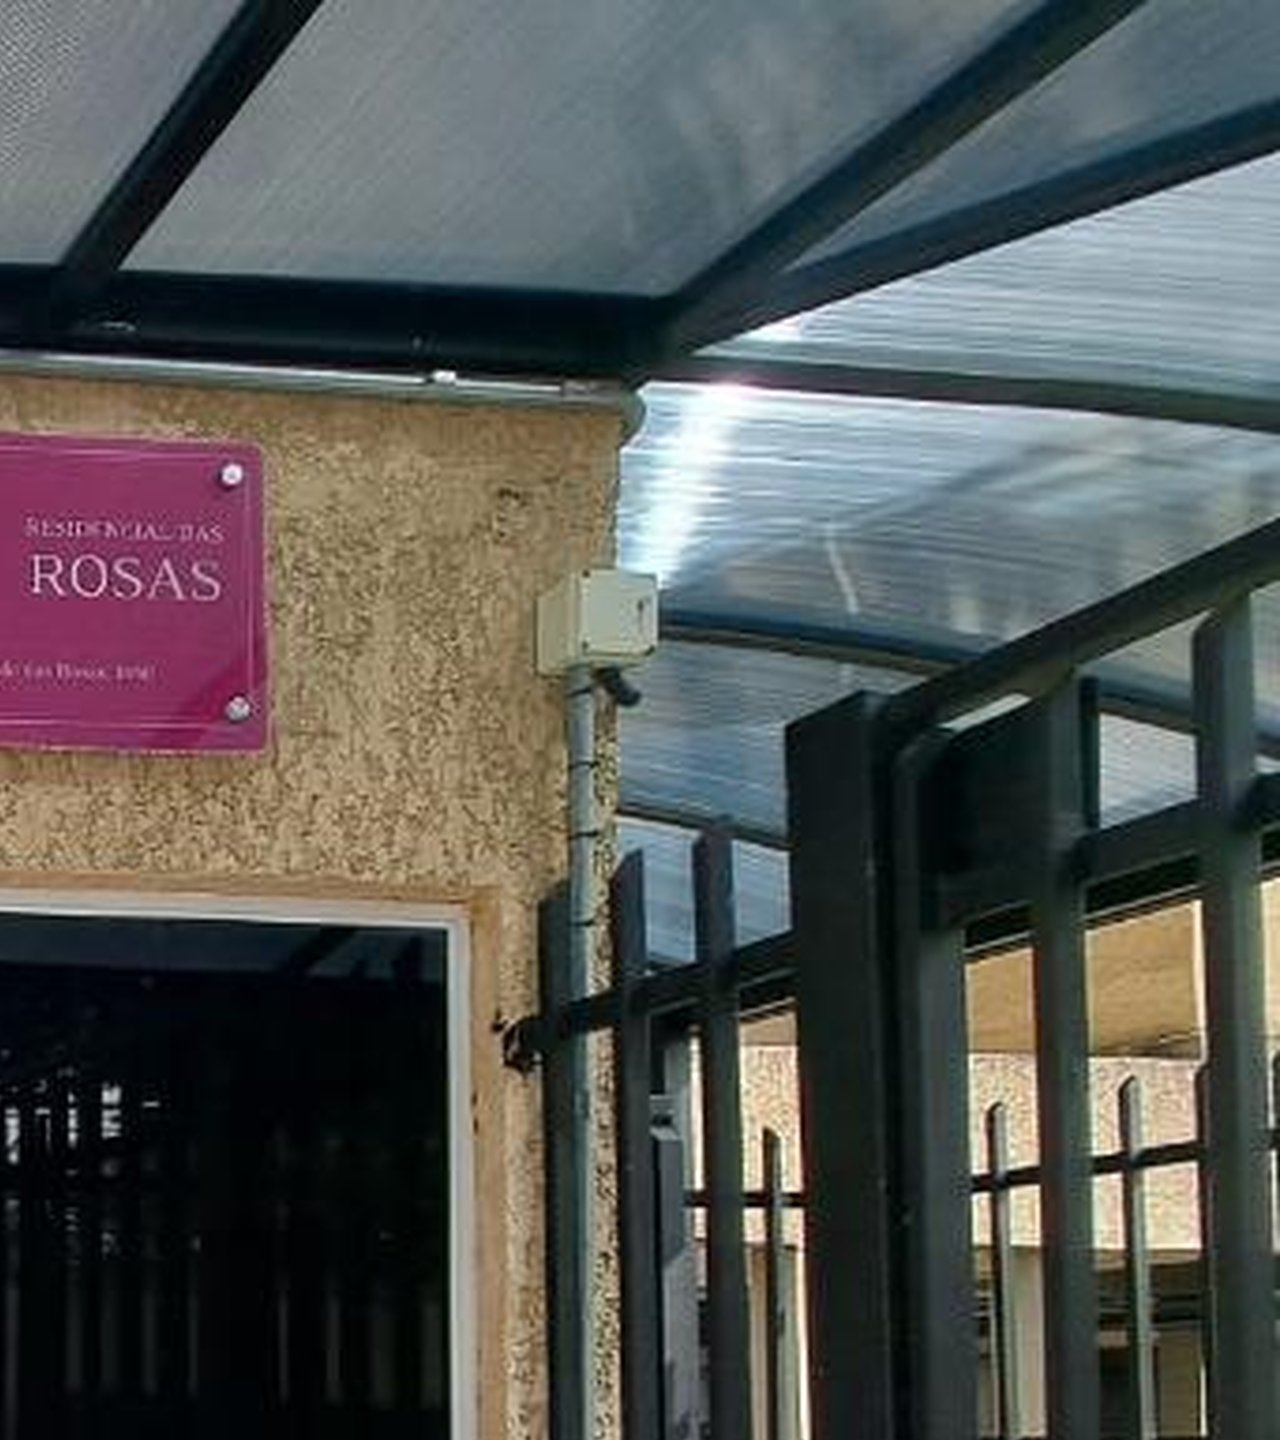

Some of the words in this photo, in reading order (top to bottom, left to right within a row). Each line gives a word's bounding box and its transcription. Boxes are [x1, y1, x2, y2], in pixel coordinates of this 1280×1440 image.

[25, 516, 173, 542] RESIDENCIAL
[179, 523, 225, 544] DAS
[30, 553, 222, 602] ROSAS
